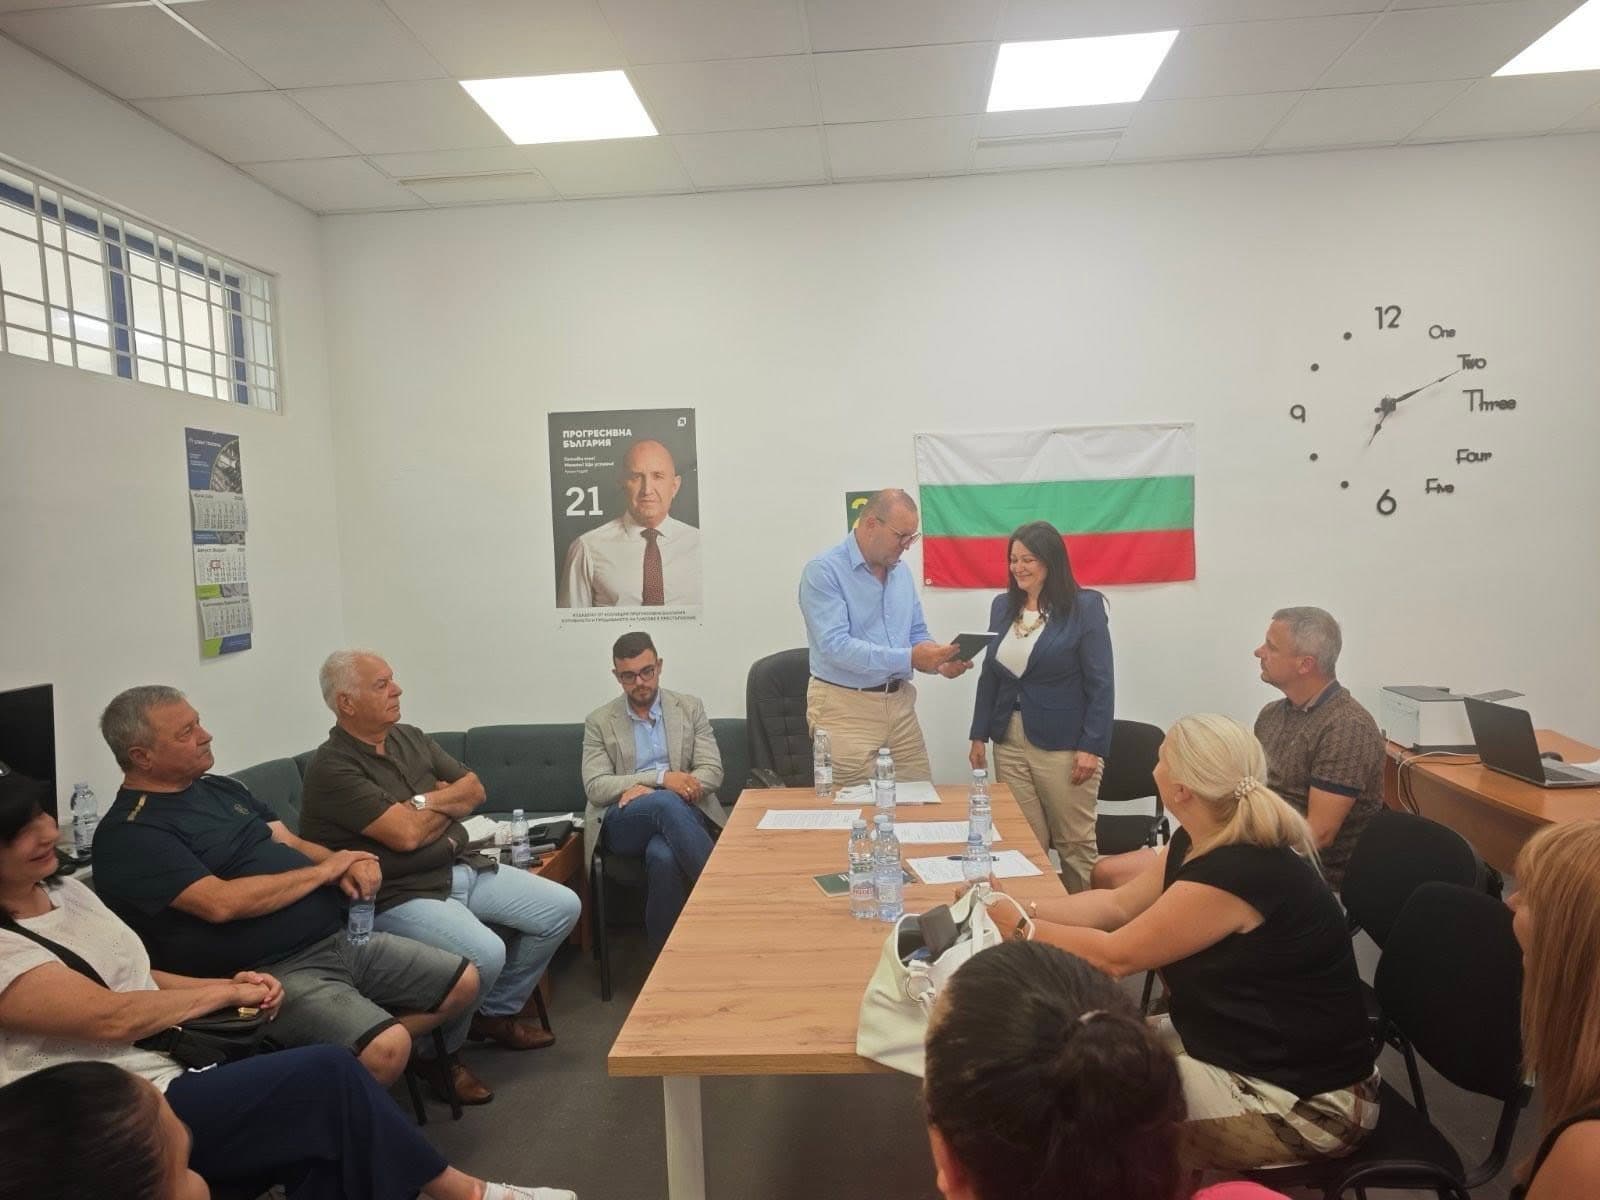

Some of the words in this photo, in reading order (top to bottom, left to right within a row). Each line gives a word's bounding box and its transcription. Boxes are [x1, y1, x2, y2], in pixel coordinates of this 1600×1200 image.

[1374, 305, 1402, 330] 12
[1428, 324, 1456, 340] One
[1457, 353, 1487, 370] Two
[1462, 388, 1517, 412] Three
[1289, 404, 1306, 423] 9
[562, 428, 632, 438] ПРОГРЕСИВНА
[562, 438, 612, 448] БЪЛГАРИЯ
[1456, 448, 1492, 464] Four
[1425, 478, 1455, 494] Five
[565, 486, 604, 516] 21
[1376, 489, 1397, 515] 6
